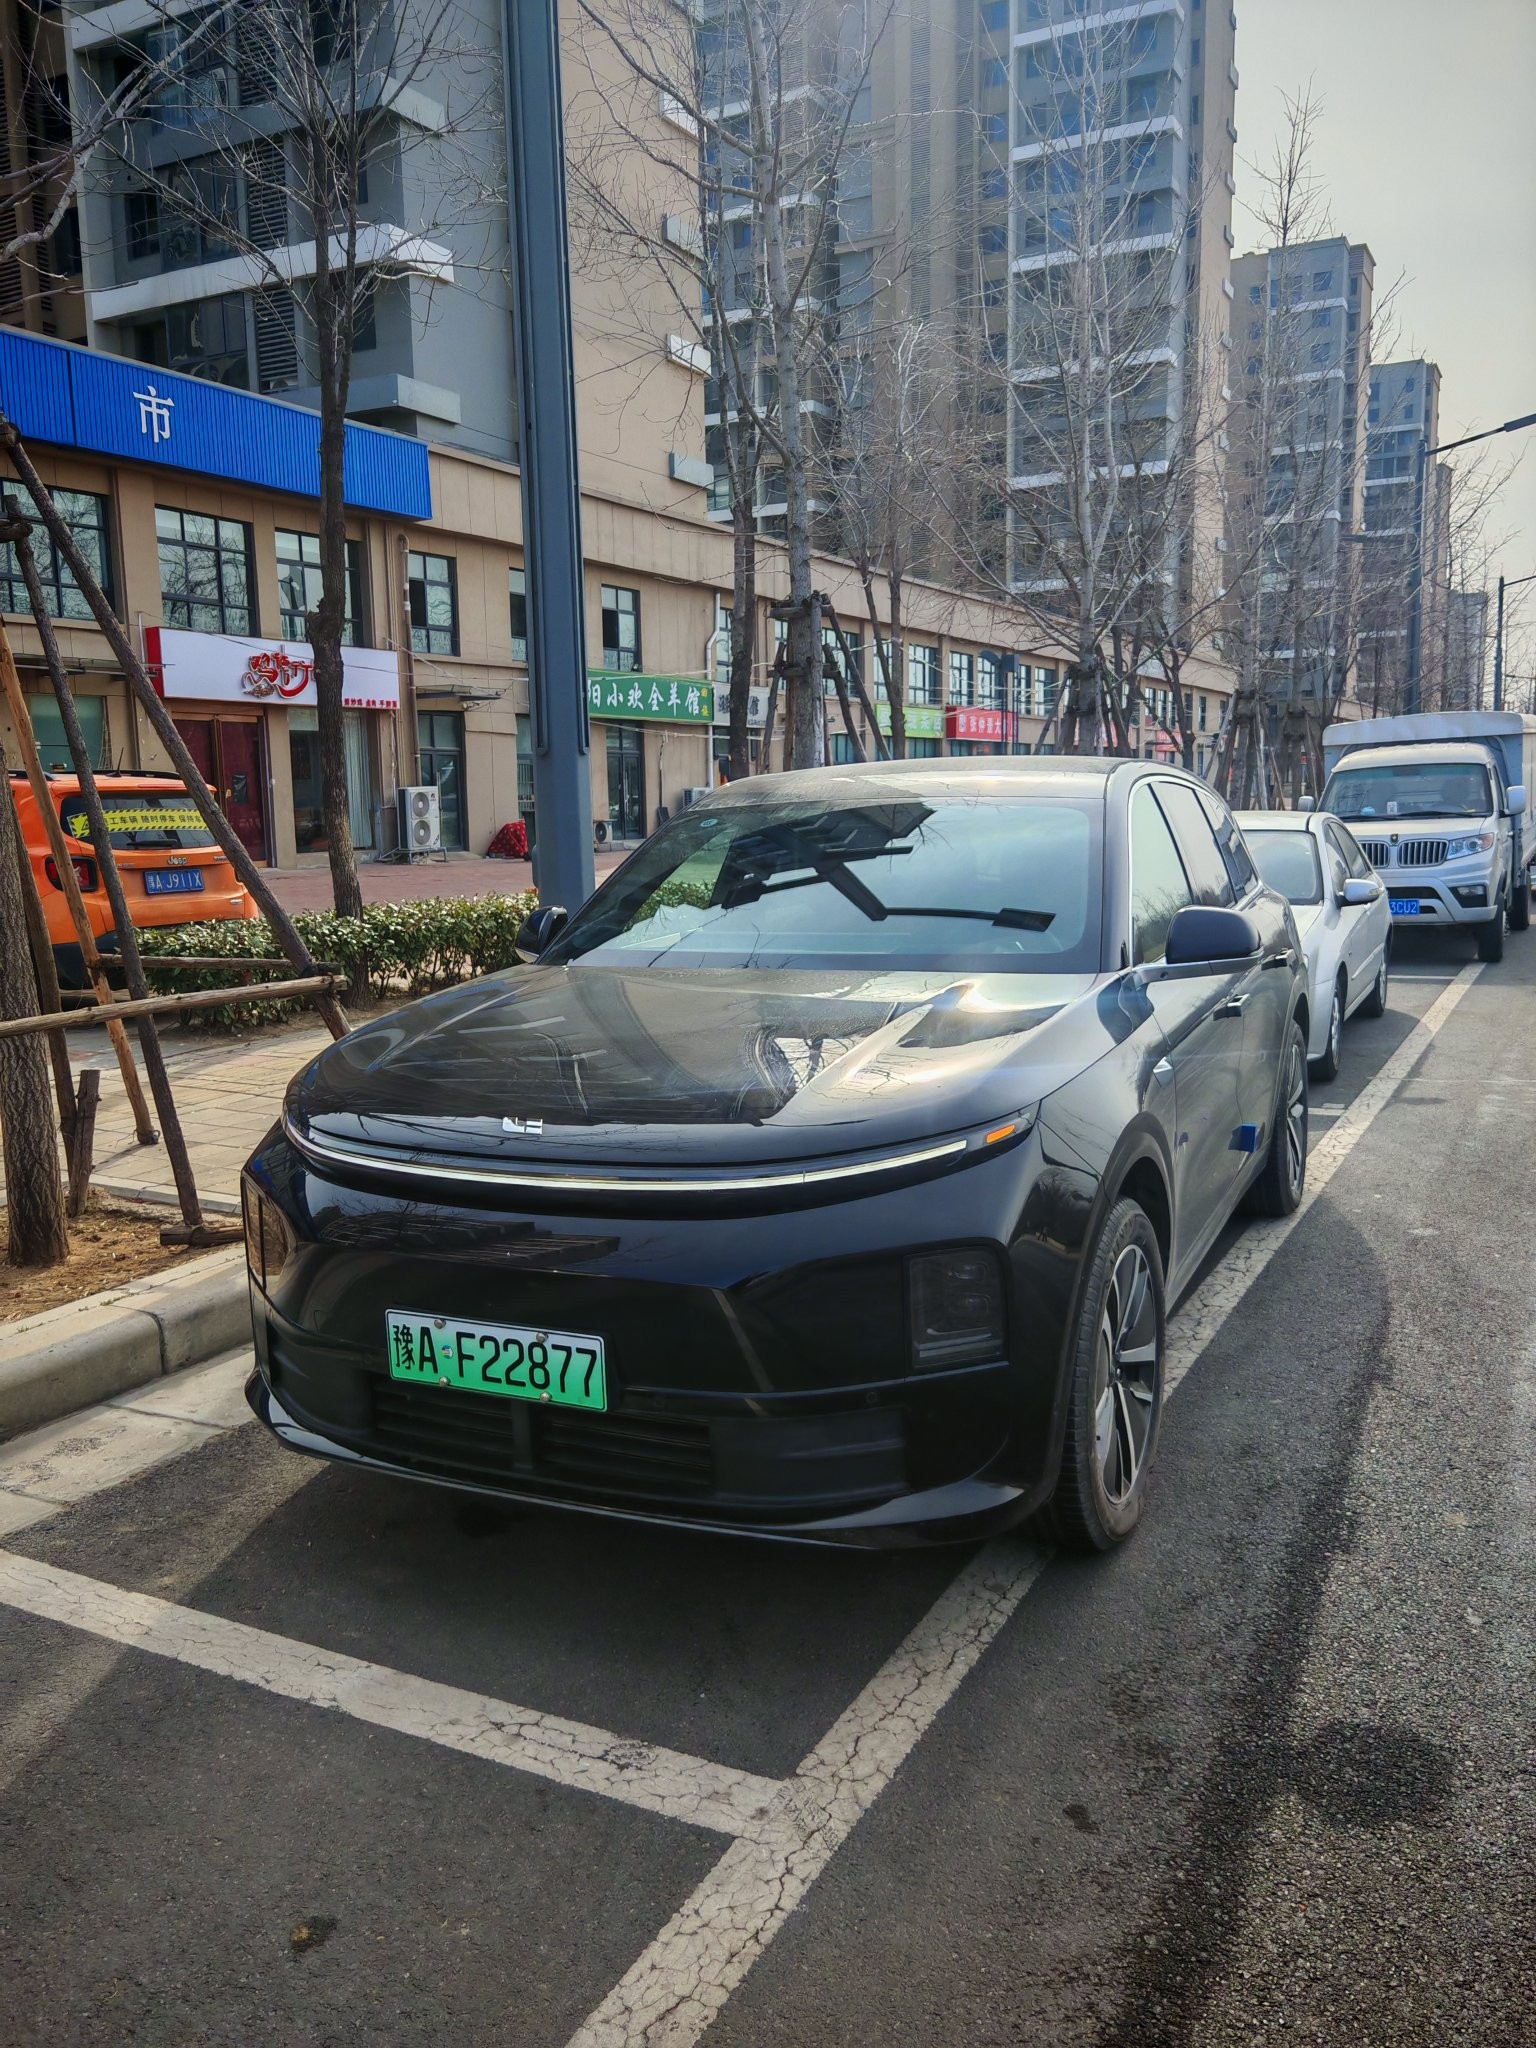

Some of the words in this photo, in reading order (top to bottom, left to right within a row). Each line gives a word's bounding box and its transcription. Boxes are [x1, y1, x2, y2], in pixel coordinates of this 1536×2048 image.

[132, 385, 175, 443] 市
[104, 815, 138, 826] 工车辆
[167, 855, 188, 865] Jeep
